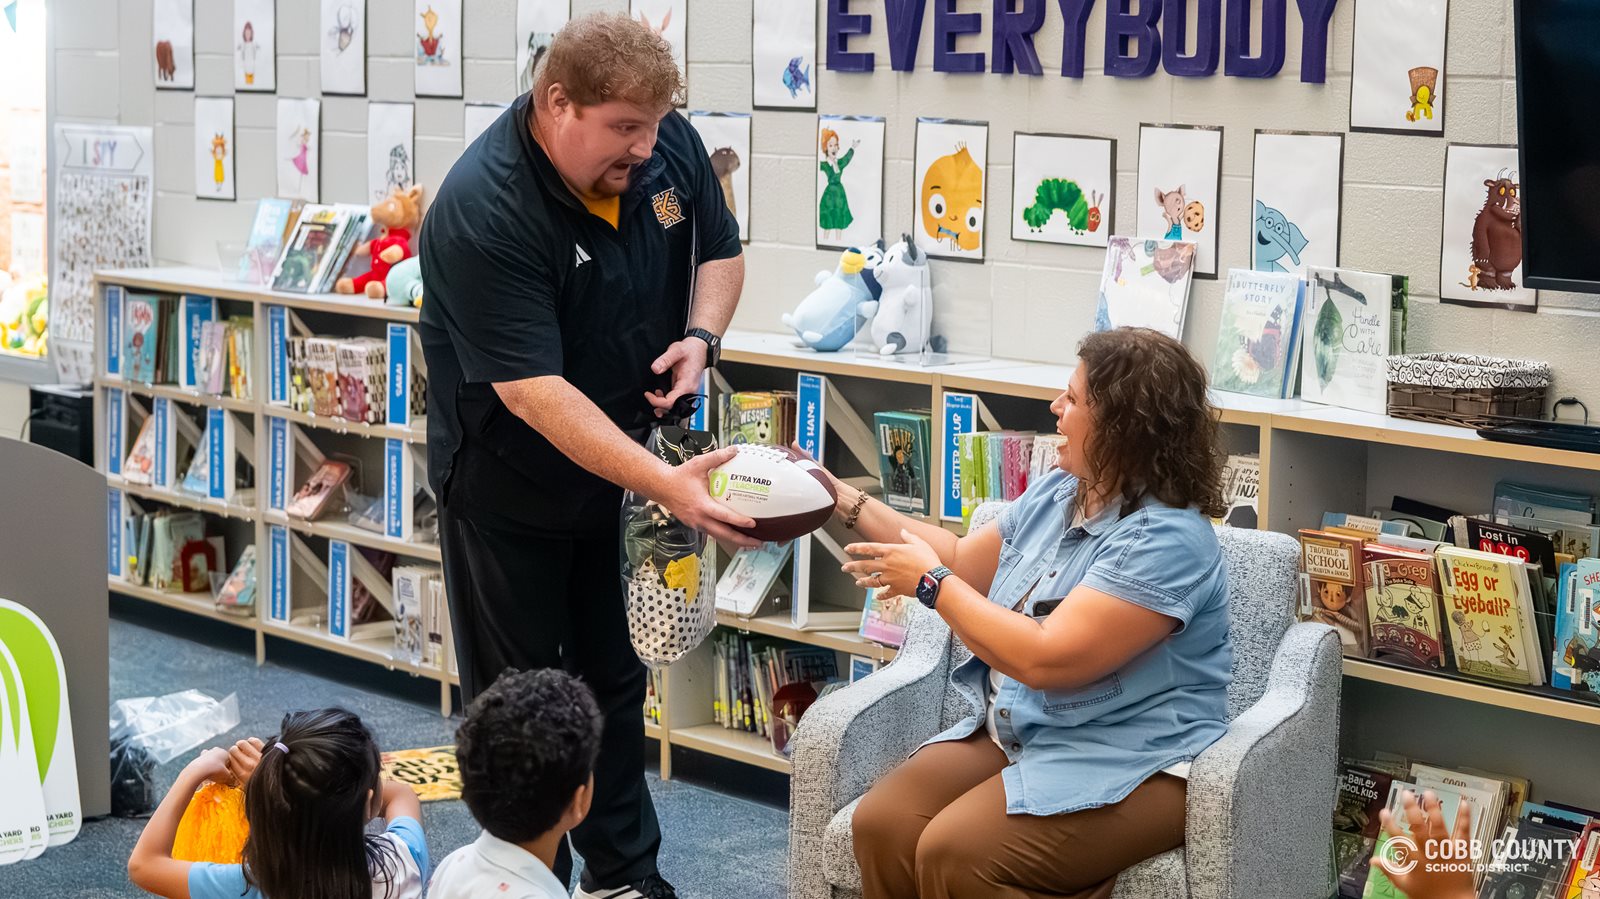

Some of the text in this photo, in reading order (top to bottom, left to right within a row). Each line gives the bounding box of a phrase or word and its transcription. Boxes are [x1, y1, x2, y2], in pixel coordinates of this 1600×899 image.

[826, 0, 1339, 83] EVERYBODY
[1236, 280, 1286, 293] BUTTERFLY
[1244, 293, 1273, 304] STORY
[1352, 306, 1381, 327] Handle
[1342, 324, 1383, 357] Care
[1360, 328, 1376, 336] WITH
[806, 400, 816, 437] HANK
[952, 413, 962, 499] CRITTER CLUB
[730, 473, 772, 486] EXTRA YARD
[1479, 527, 1503, 542] Lost
[1507, 534, 1518, 545] in
[1309, 545, 1339, 557] TROUBLE
[1307, 554, 1349, 571] SCHOOL
[1397, 562, 1427, 580] Greg
[1453, 567, 1499, 592] Egg or
[1453, 593, 1511, 617] Eyeball?
[1360, 787, 1379, 800] KIDS
[54, 812, 74, 820] YARD
[3, 829, 23, 838] YARD
